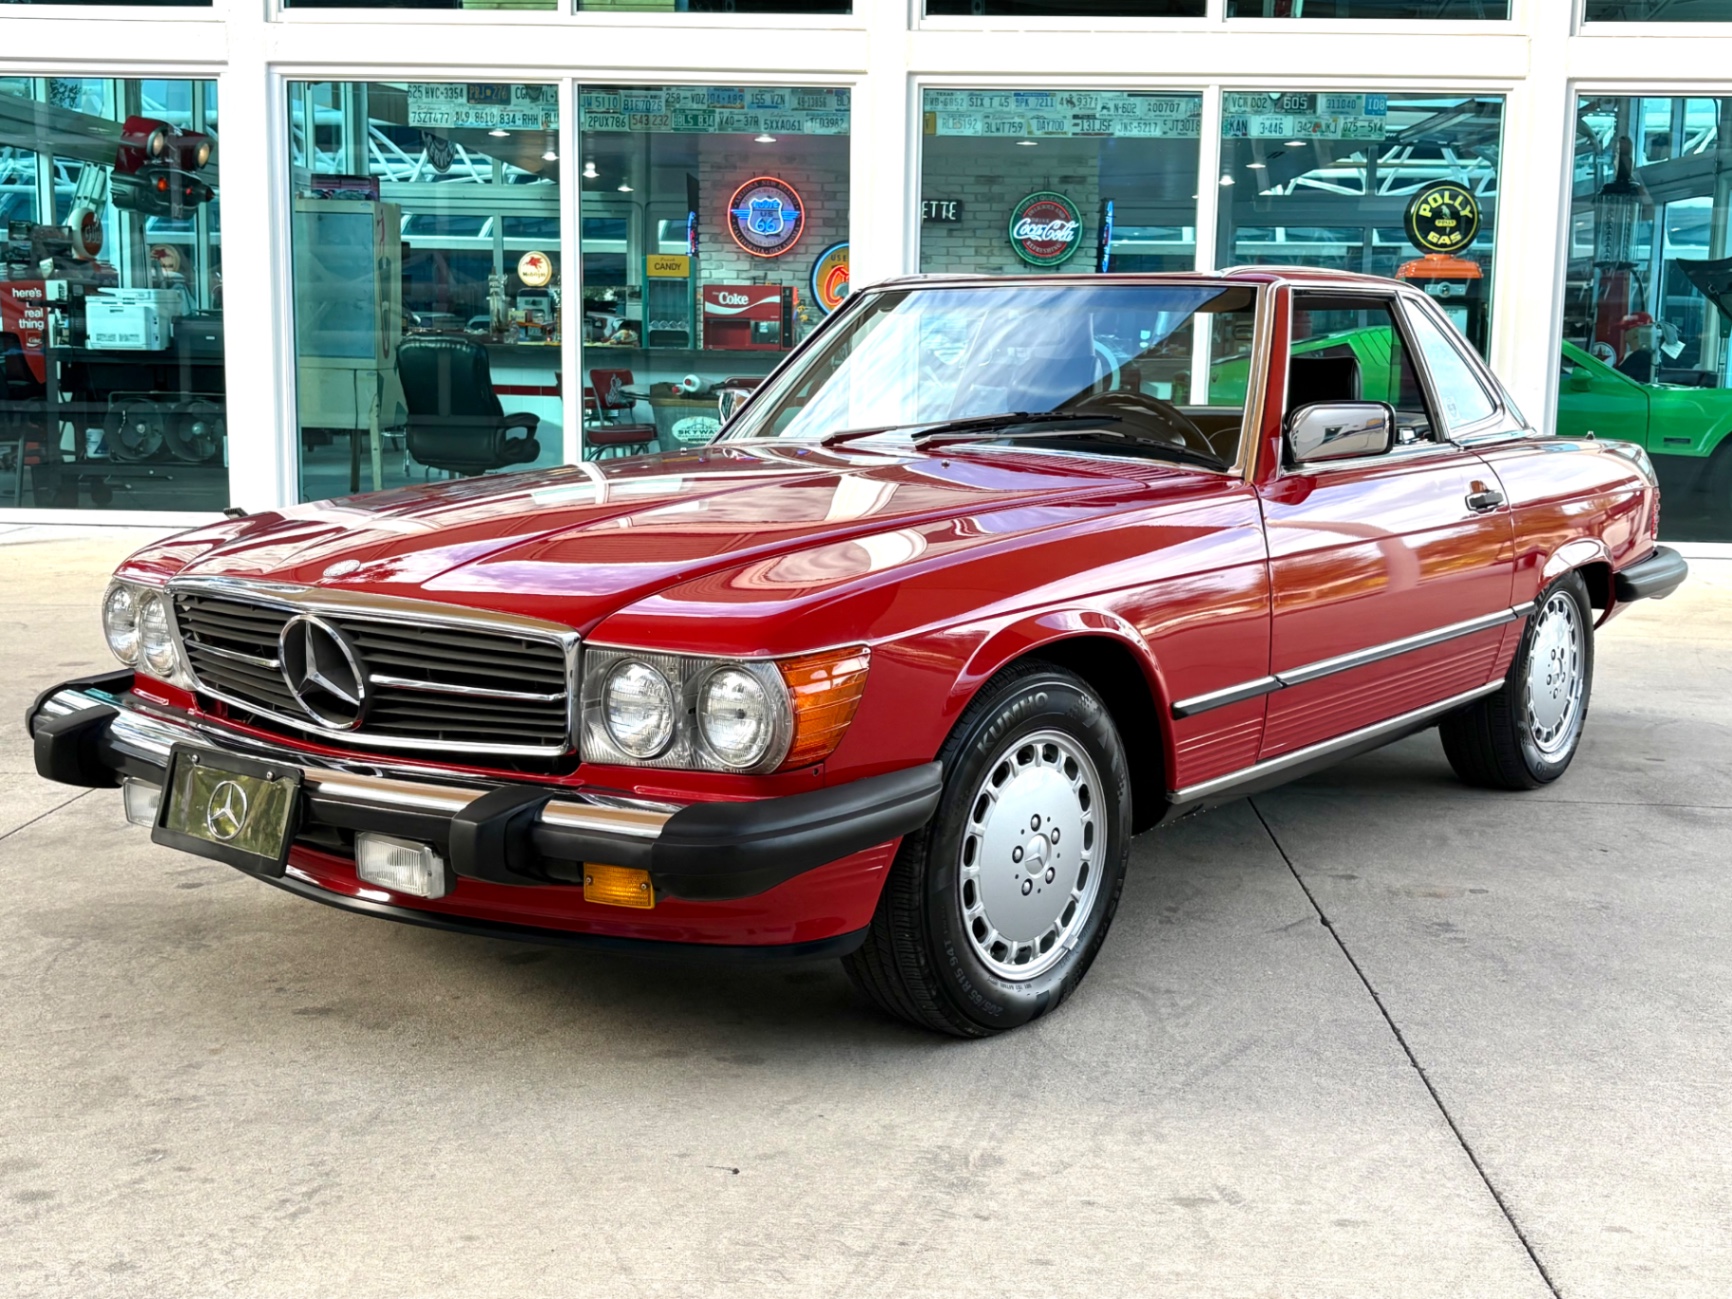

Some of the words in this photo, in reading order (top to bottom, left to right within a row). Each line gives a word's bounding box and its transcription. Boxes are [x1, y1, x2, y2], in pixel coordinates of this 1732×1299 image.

[588, 115, 627, 128] 2PUX786
[1418, 190, 1474, 219] POLLY
[755, 217, 776, 232] 66
[1427, 230, 1463, 245] GAS
[654, 262, 682, 271] CANDY
[12, 287, 43, 298] here's
[718, 291, 750, 305] Coke
[24, 307, 44, 319] real
[18, 318, 45, 331] thing
[977, 691, 1049, 756] KUMHO
